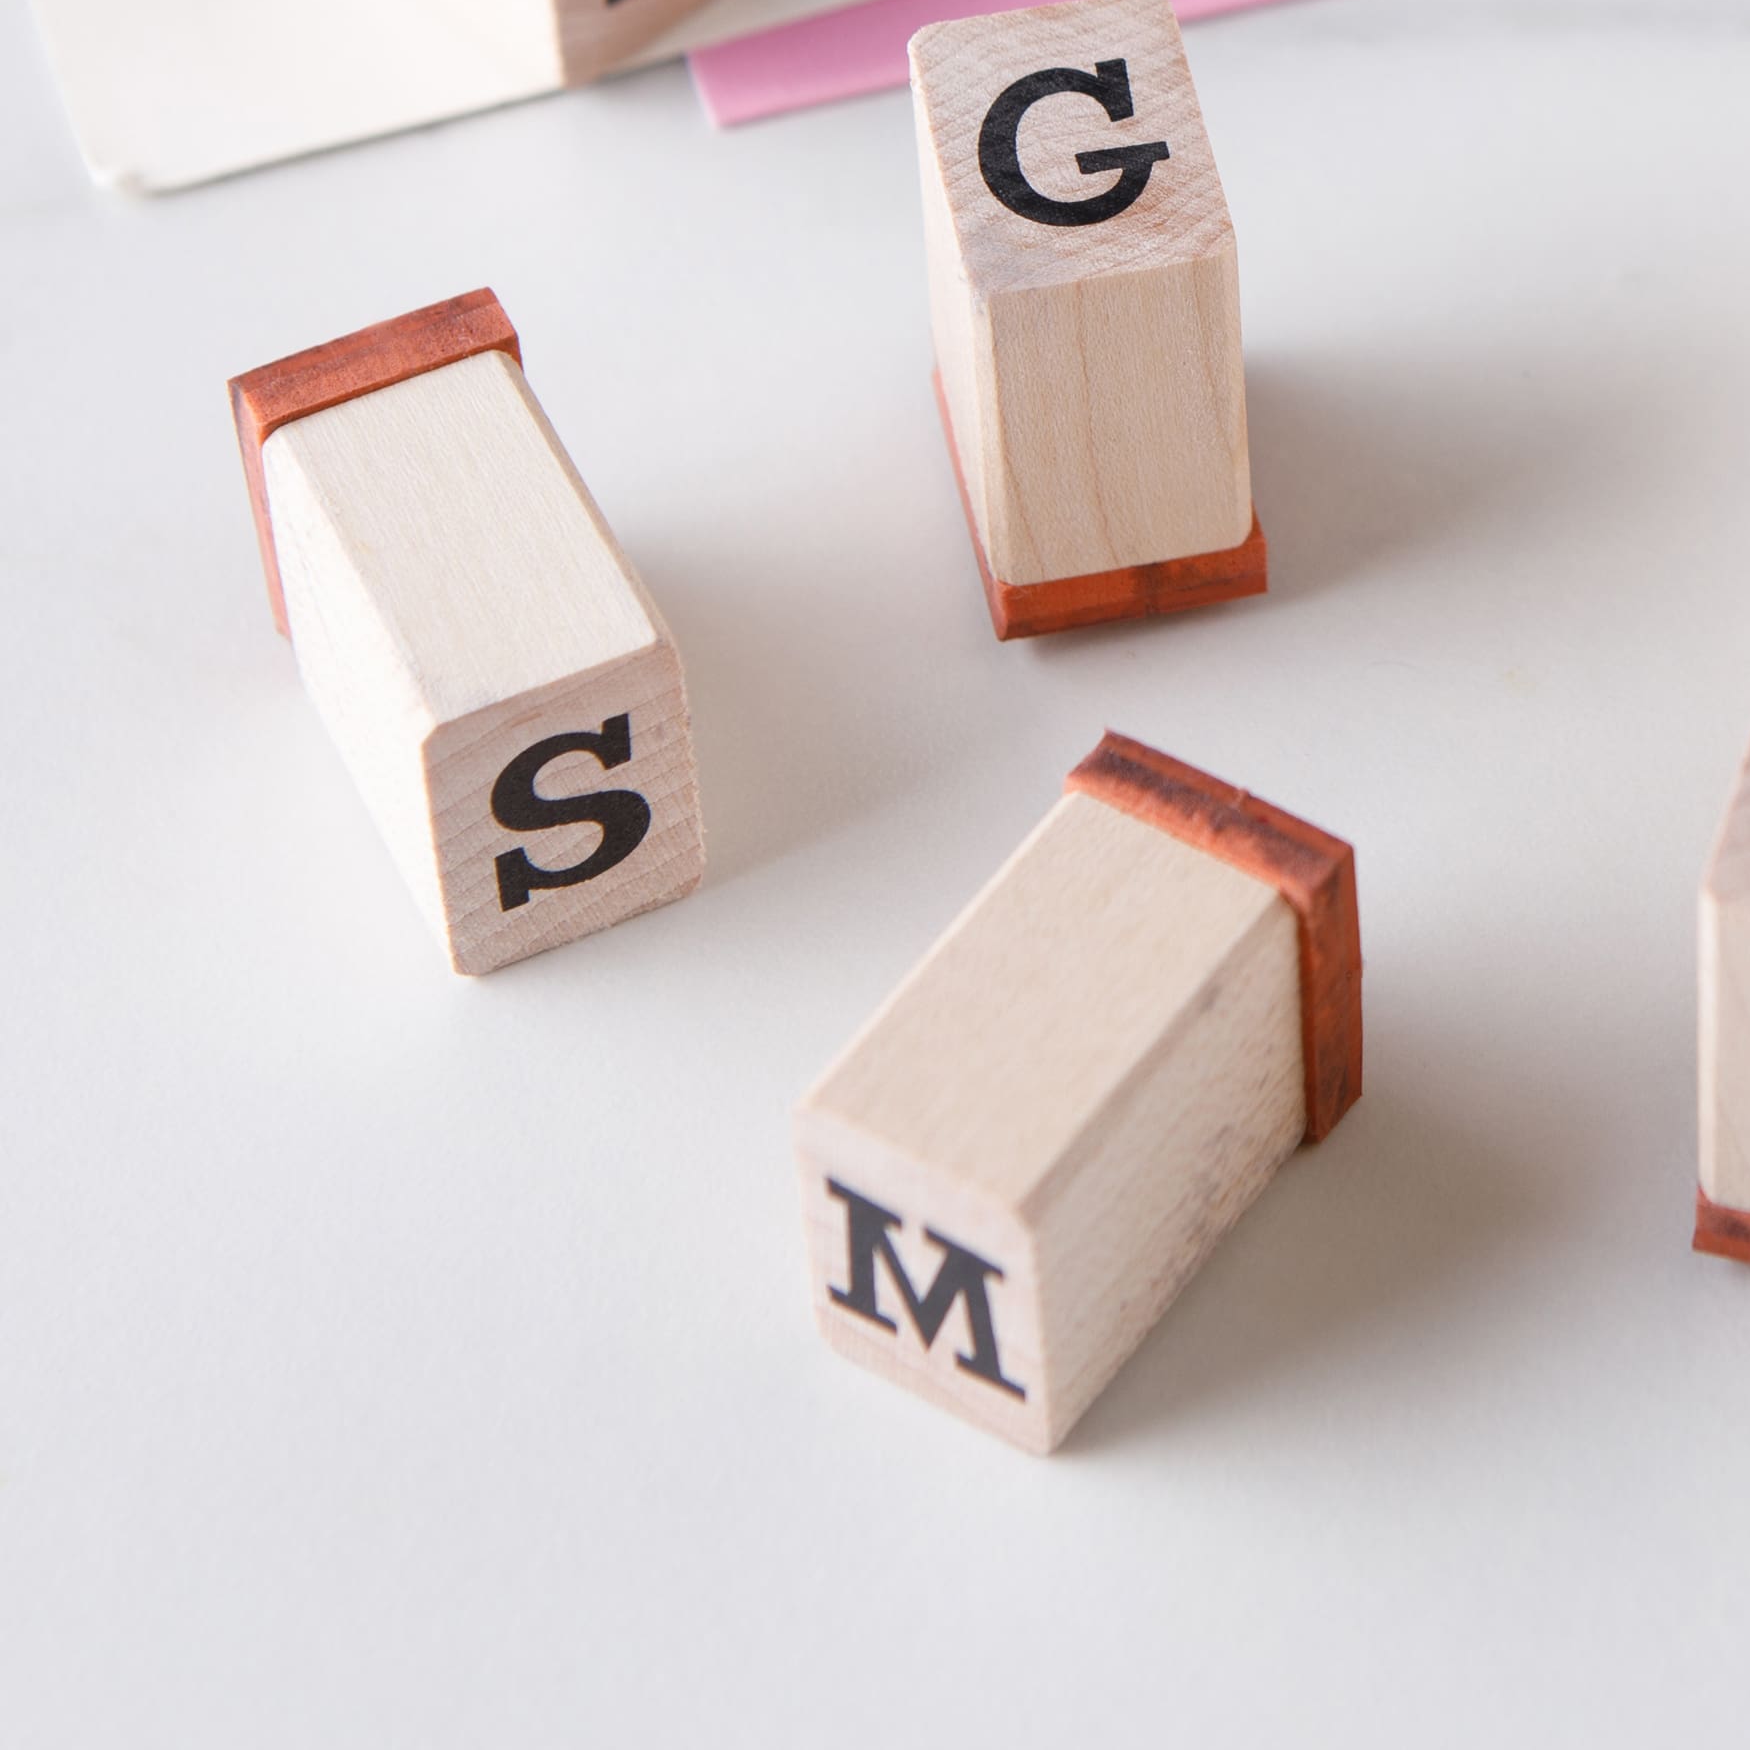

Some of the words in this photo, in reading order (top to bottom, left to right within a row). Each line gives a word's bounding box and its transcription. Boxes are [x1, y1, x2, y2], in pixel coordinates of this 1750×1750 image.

[978, 59, 1170, 227] G
[491, 713, 651, 911] S
[831, 1182, 1024, 1395] M
